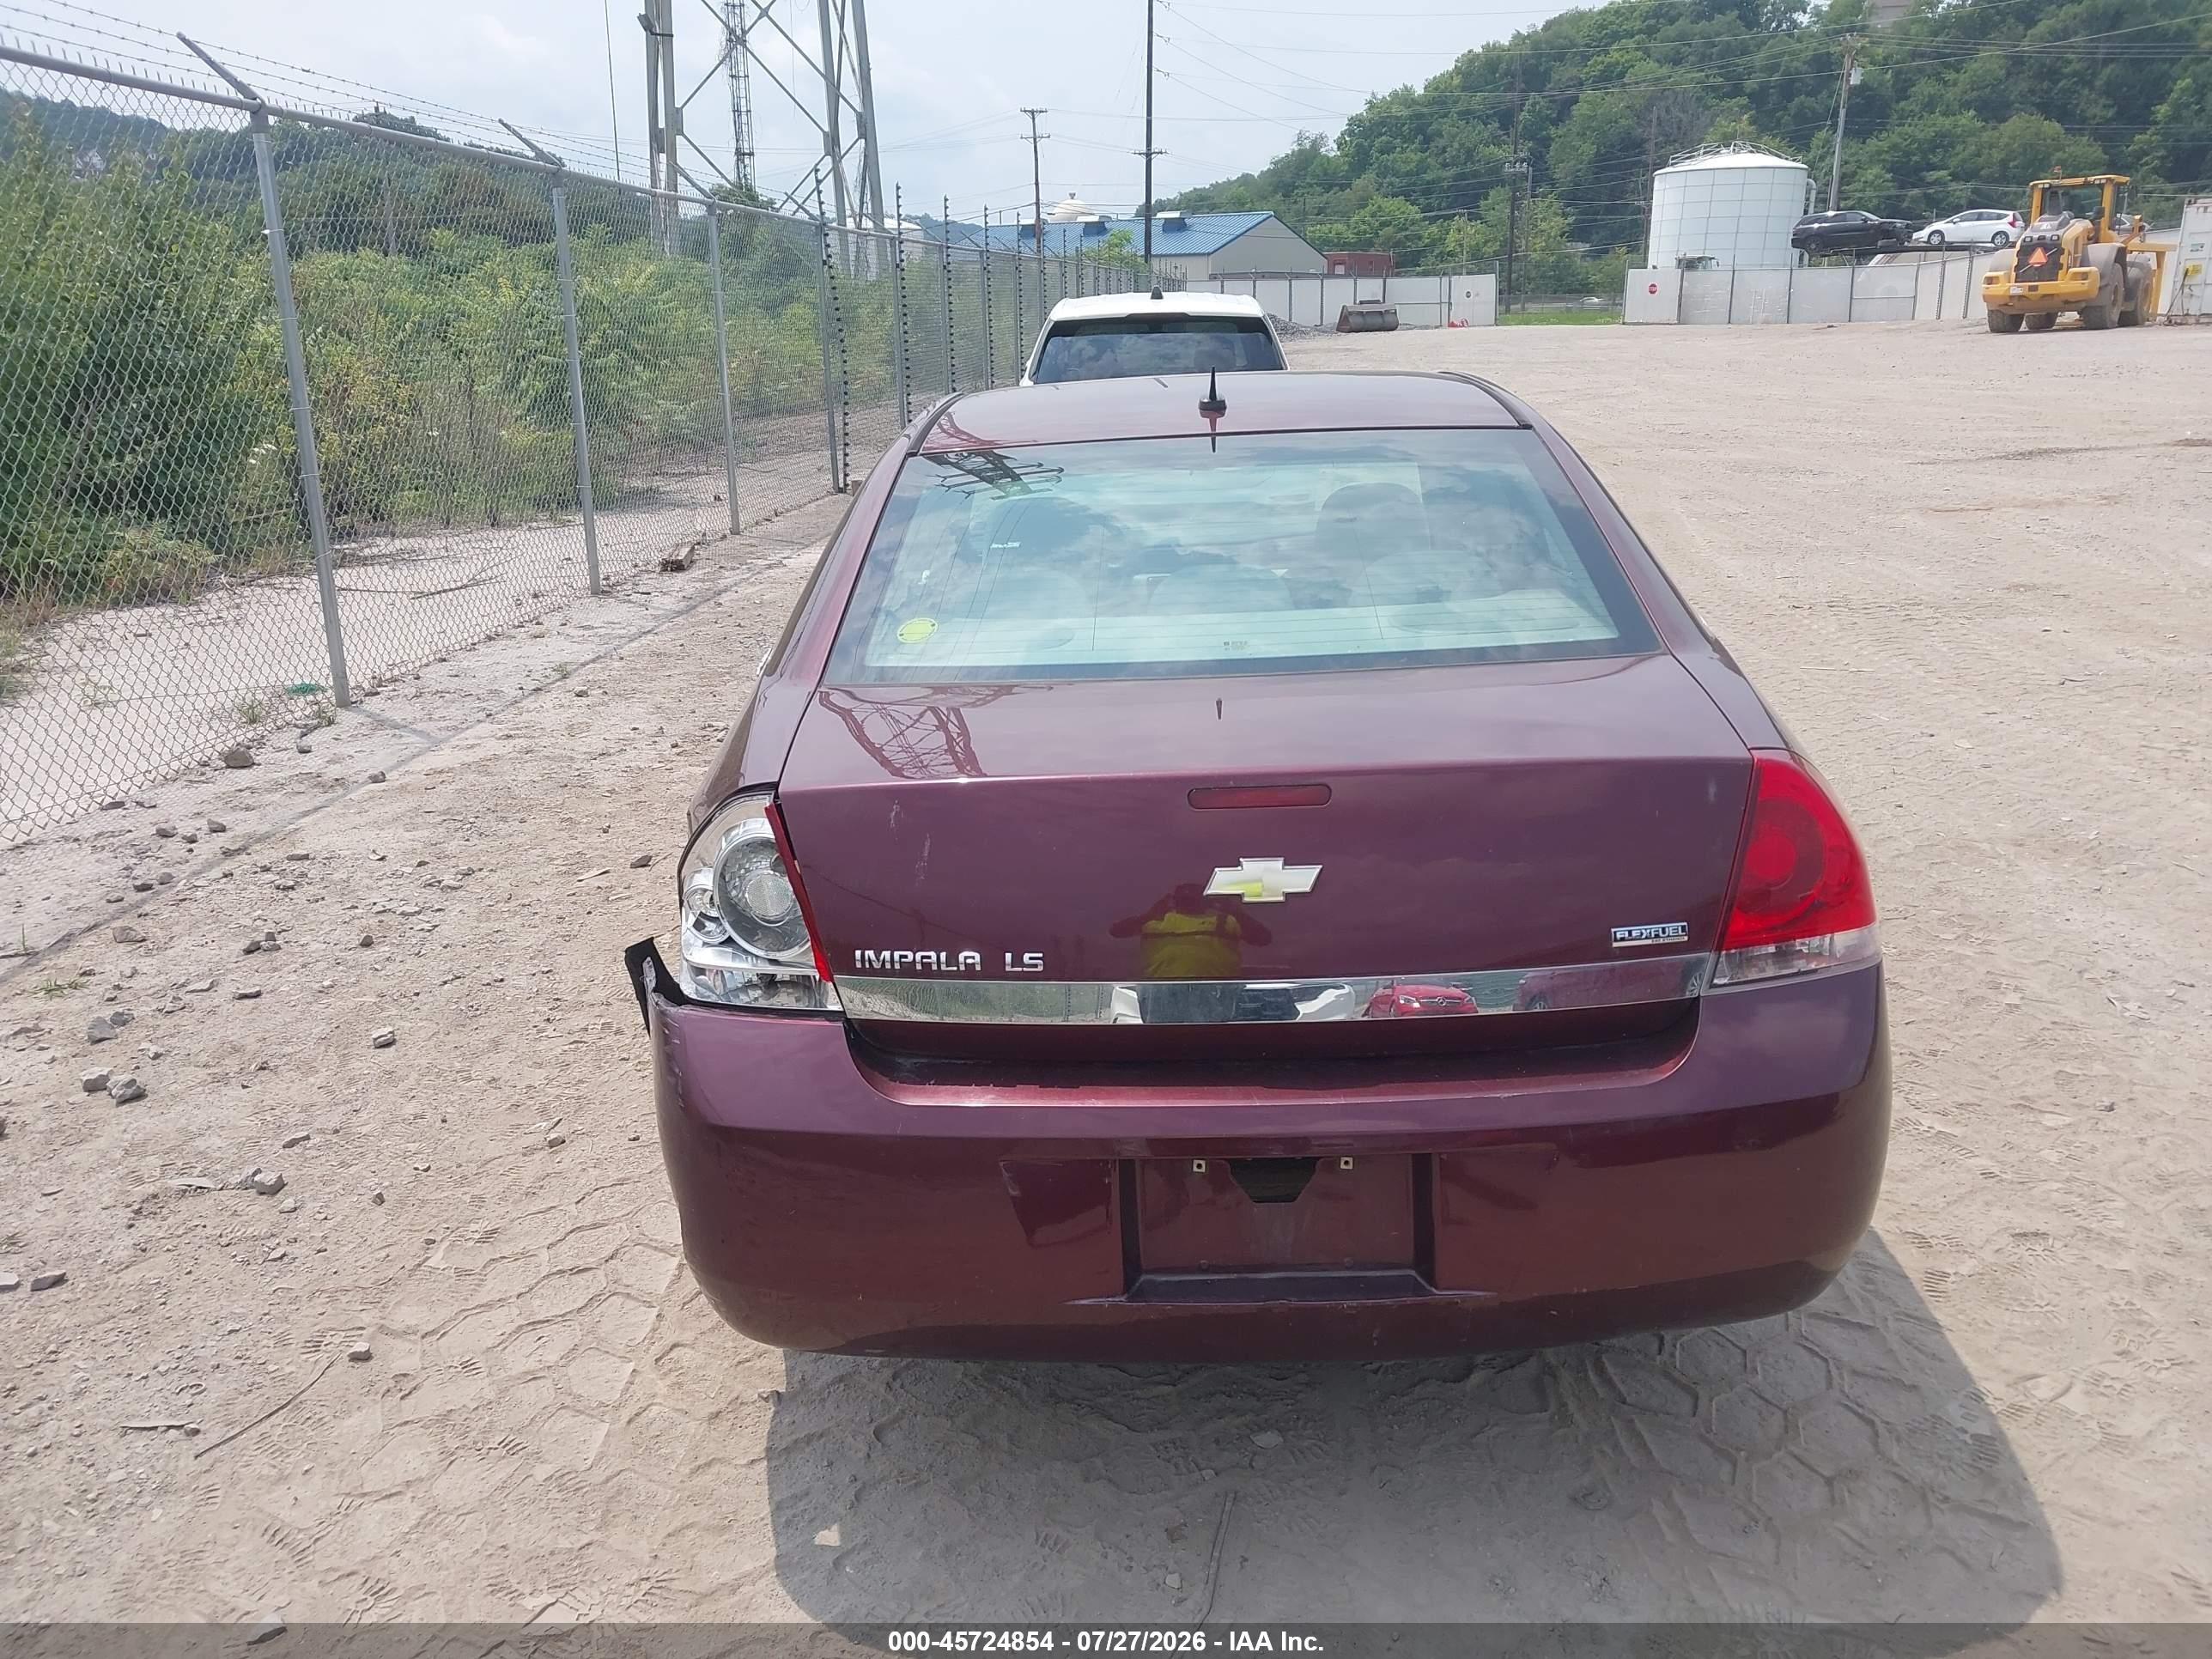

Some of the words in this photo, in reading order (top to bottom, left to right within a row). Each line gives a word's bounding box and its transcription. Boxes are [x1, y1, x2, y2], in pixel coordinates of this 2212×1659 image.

[1615, 925, 1686, 941] FLEXFUEL
[854, 950, 981, 971] IMPALA
[1005, 952, 1043, 971] LS
